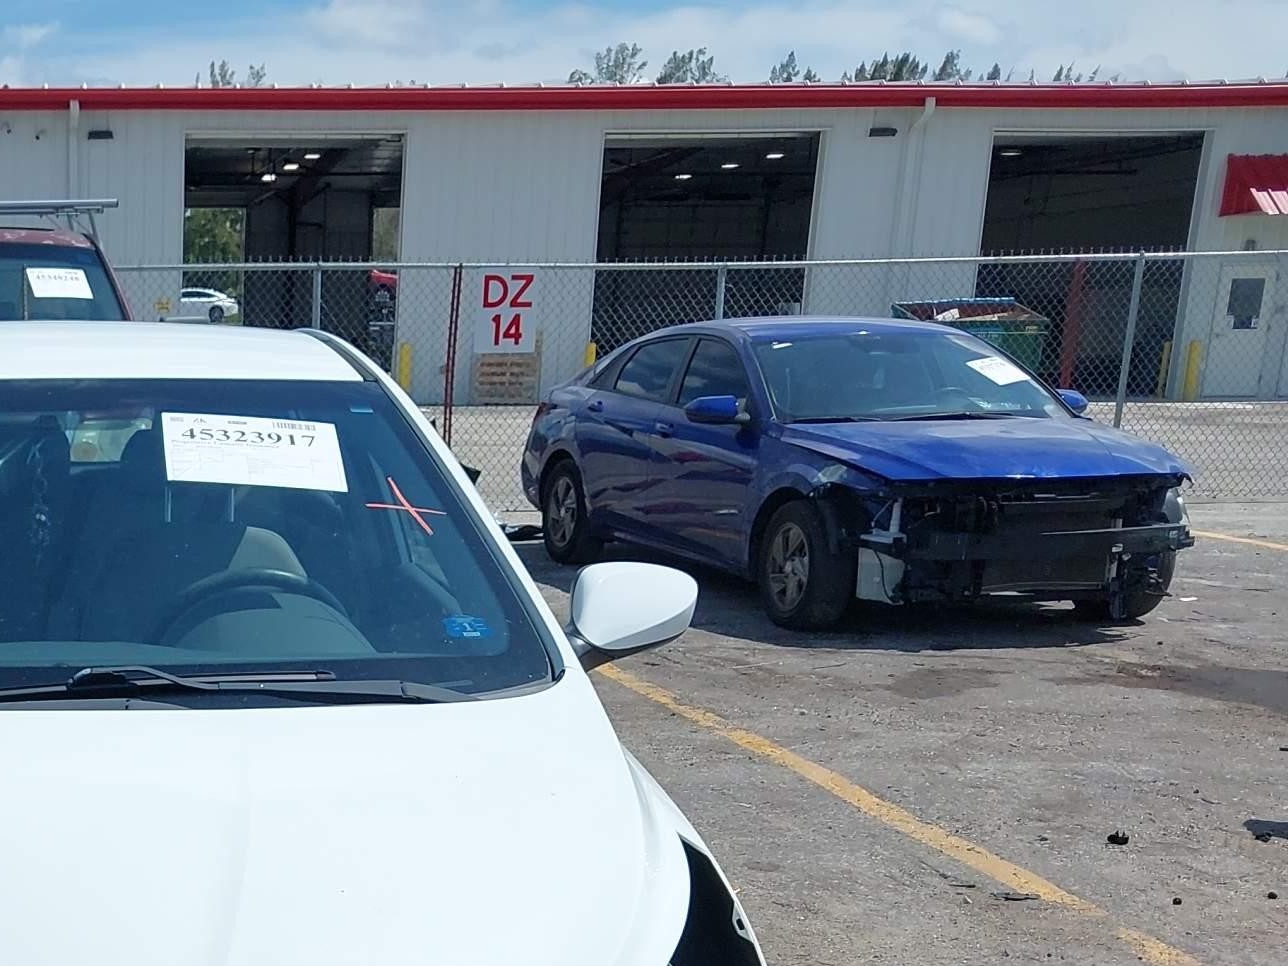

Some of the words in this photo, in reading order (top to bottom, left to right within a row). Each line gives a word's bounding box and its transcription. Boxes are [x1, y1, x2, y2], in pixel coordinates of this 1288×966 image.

[482, 274, 535, 308] DZ
[491, 313, 523, 346] 14
[181, 427, 316, 448] 45323917
